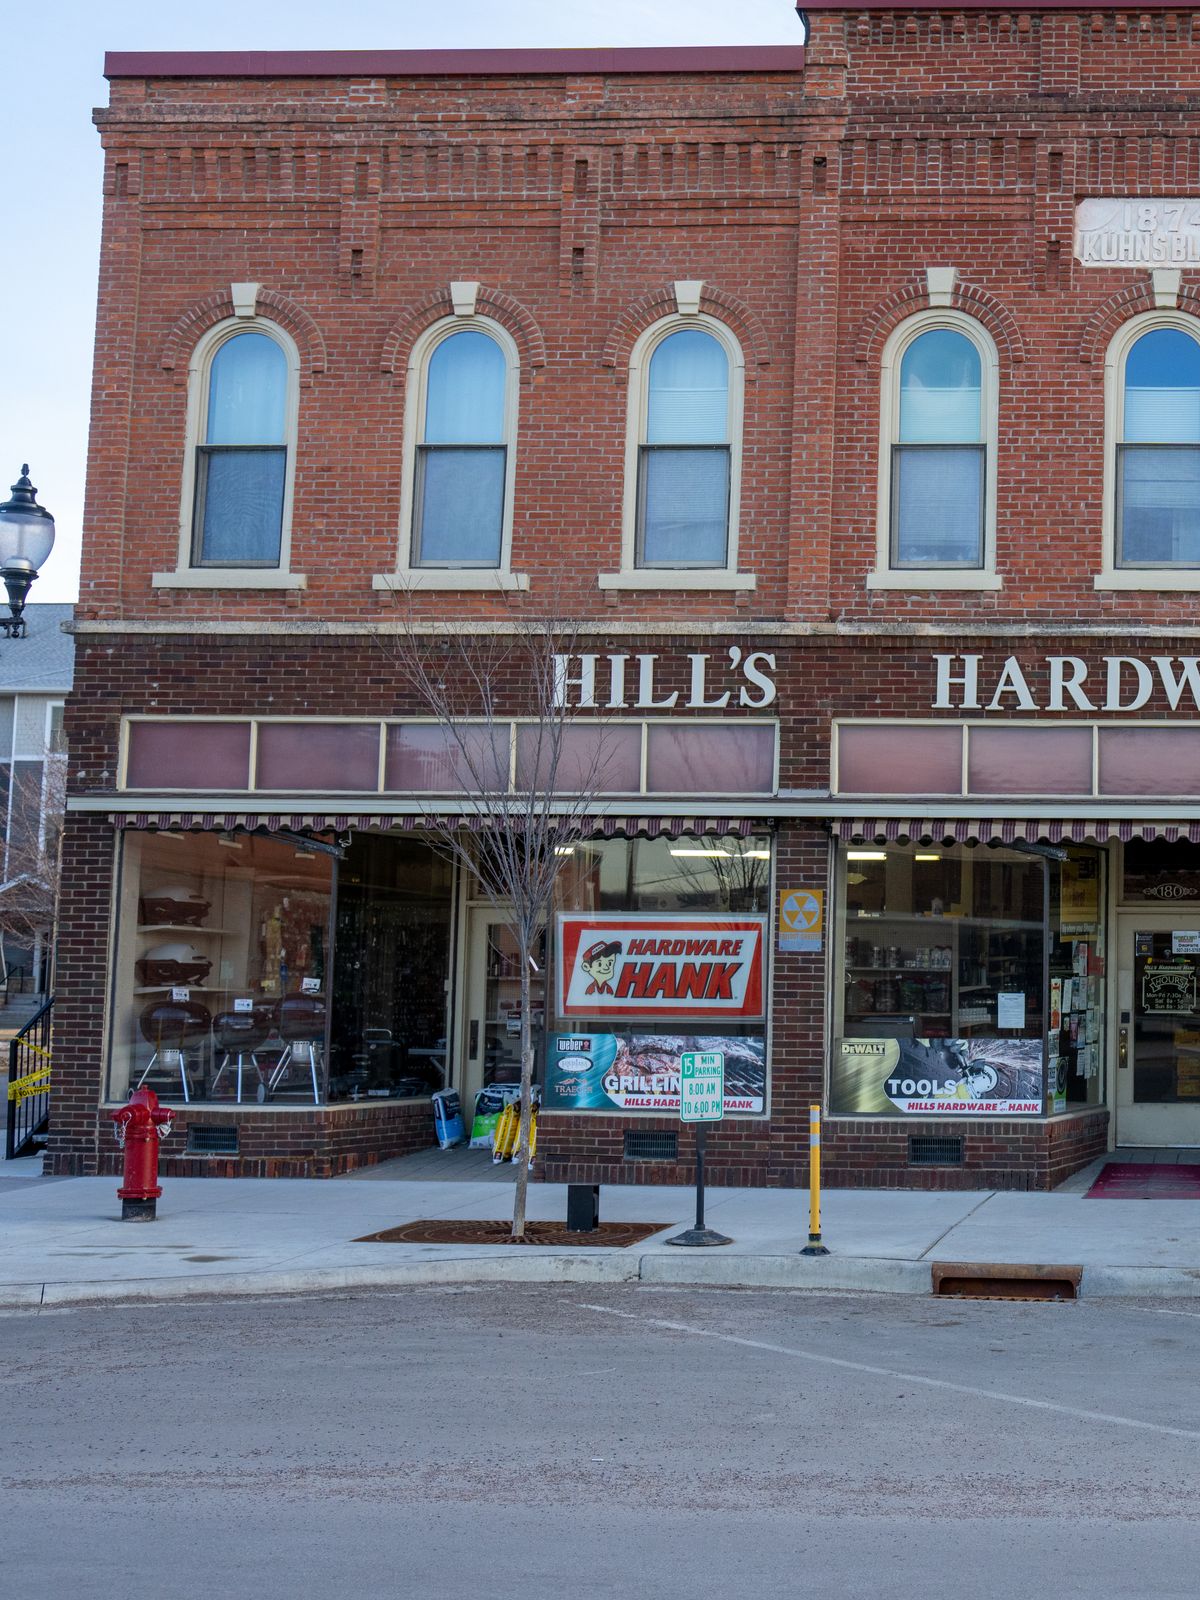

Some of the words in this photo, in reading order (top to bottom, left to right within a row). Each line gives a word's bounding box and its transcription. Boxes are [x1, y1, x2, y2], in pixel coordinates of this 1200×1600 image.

[550, 646, 777, 708] HILL'S
[1160, 885, 1182, 898] 180
[626, 938, 744, 956] HARDWARE
[614, 962, 744, 1000] HANK
[1155, 975, 1184, 987] HOURS
[559, 1038, 583, 1051] weber
[684, 1057, 693, 1075] 15
[701, 1055, 715, 1065] MIN
[695, 1066, 720, 1075] PARKING
[604, 1075, 681, 1093] GRILLIN
[706, 1083, 716, 1095] AM
[888, 1079, 957, 1095] TOOLS
[624, 1098, 652, 1107] HILLS
[653, 1098, 681, 1107] HARD
[723, 1100, 753, 1109] HANK
[684, 1101, 692, 1114] TO
[711, 1101, 721, 1113] PM
[907, 1102, 936, 1111] HILLS
[937, 1102, 998, 1111] HARDWARE
[1008, 1103, 1039, 1112] HANK
